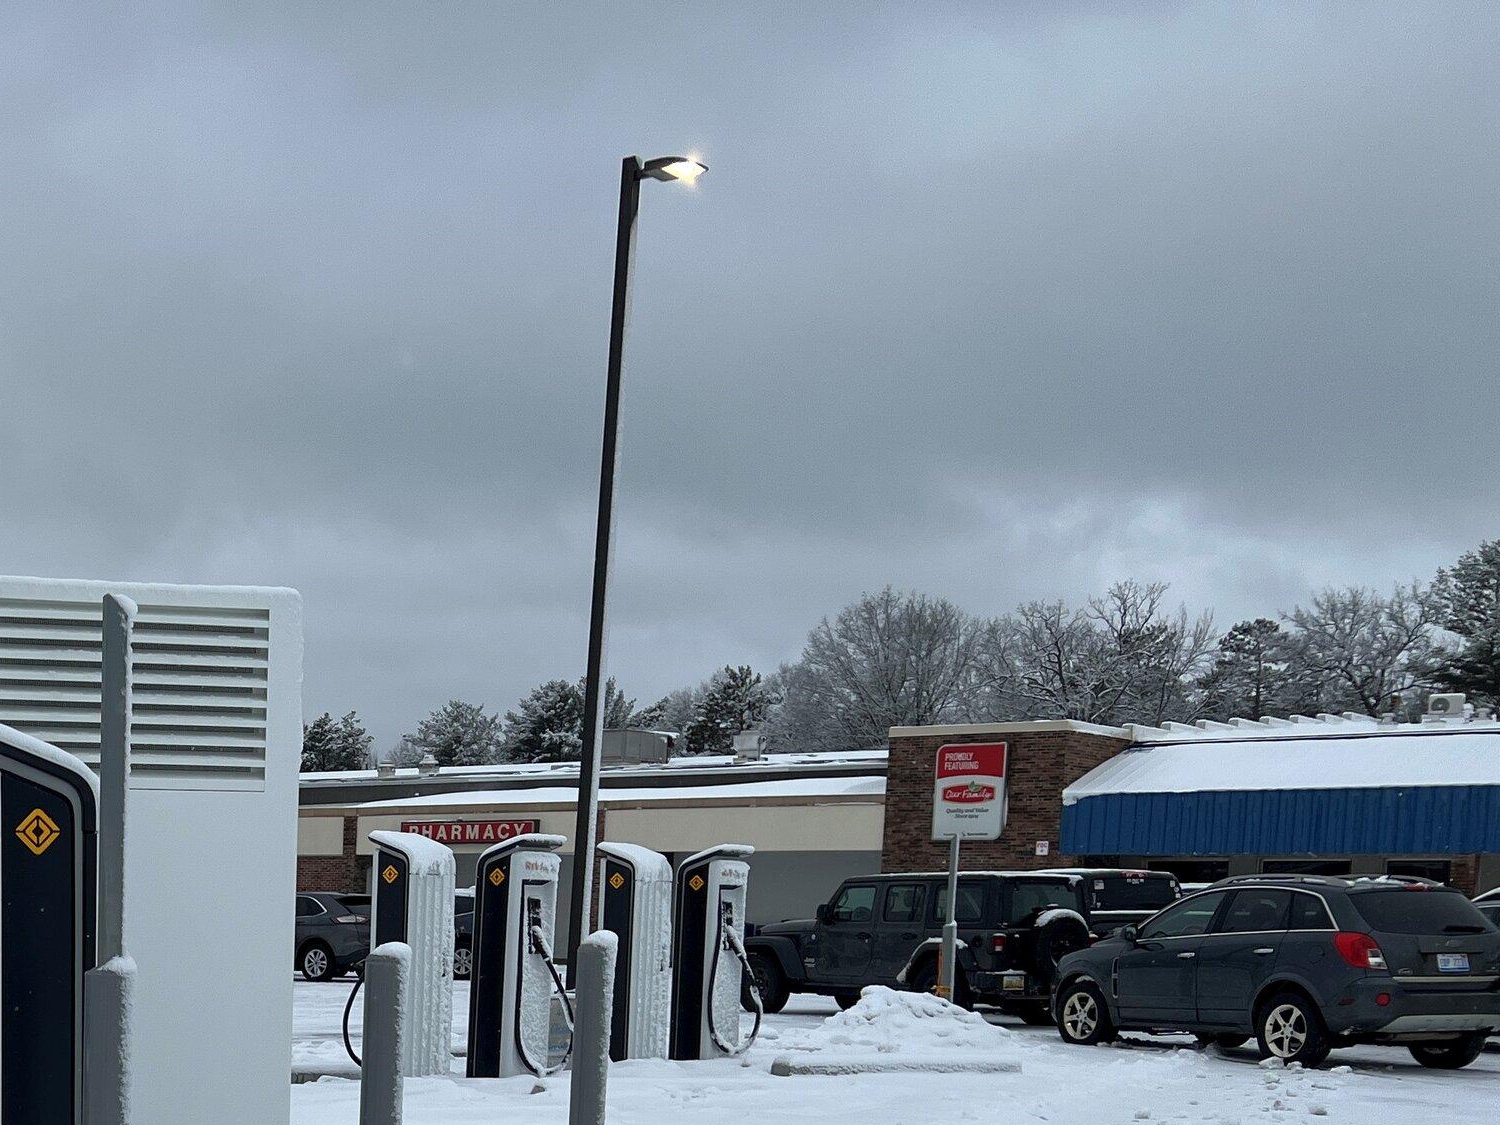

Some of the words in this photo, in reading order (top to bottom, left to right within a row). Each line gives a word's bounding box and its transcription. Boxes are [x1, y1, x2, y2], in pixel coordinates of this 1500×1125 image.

[945, 752, 974, 761] PROUDLY
[944, 761, 980, 771] FEATURING
[945, 789, 962, 799] Our
[962, 788, 993, 801] Family
